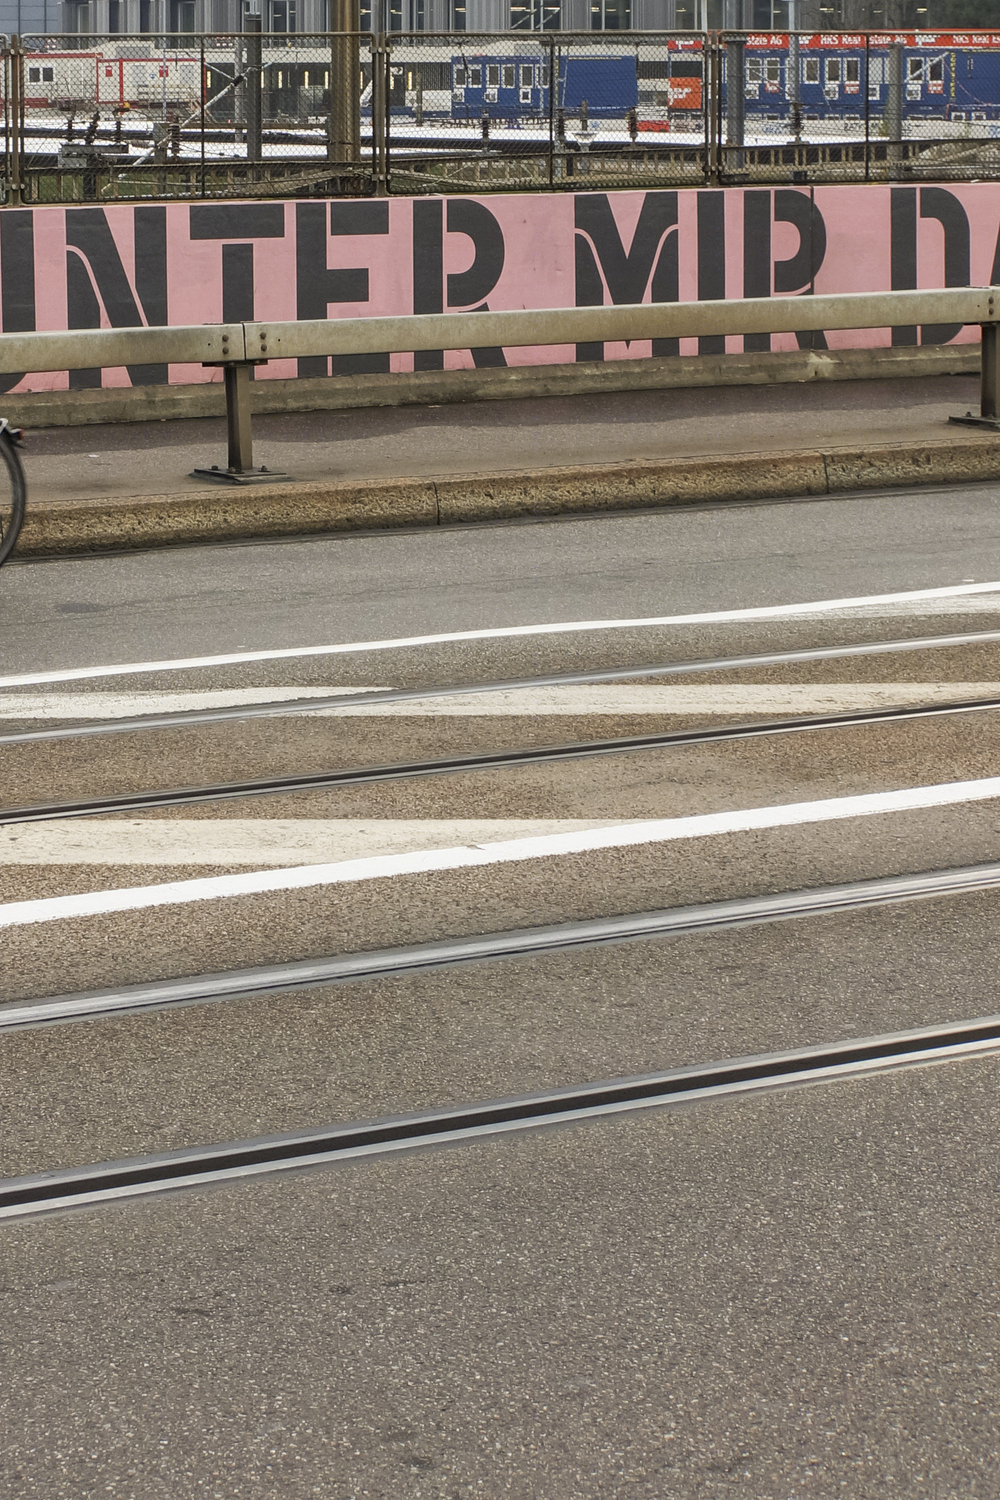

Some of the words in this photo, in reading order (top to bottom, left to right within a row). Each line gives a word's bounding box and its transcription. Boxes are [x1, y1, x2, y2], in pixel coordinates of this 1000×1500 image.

[746, 35, 768, 46] state
[770, 35, 783, 46] AG
[574, 187, 829, 363] MIR
[890, 186, 1000, 347] D
